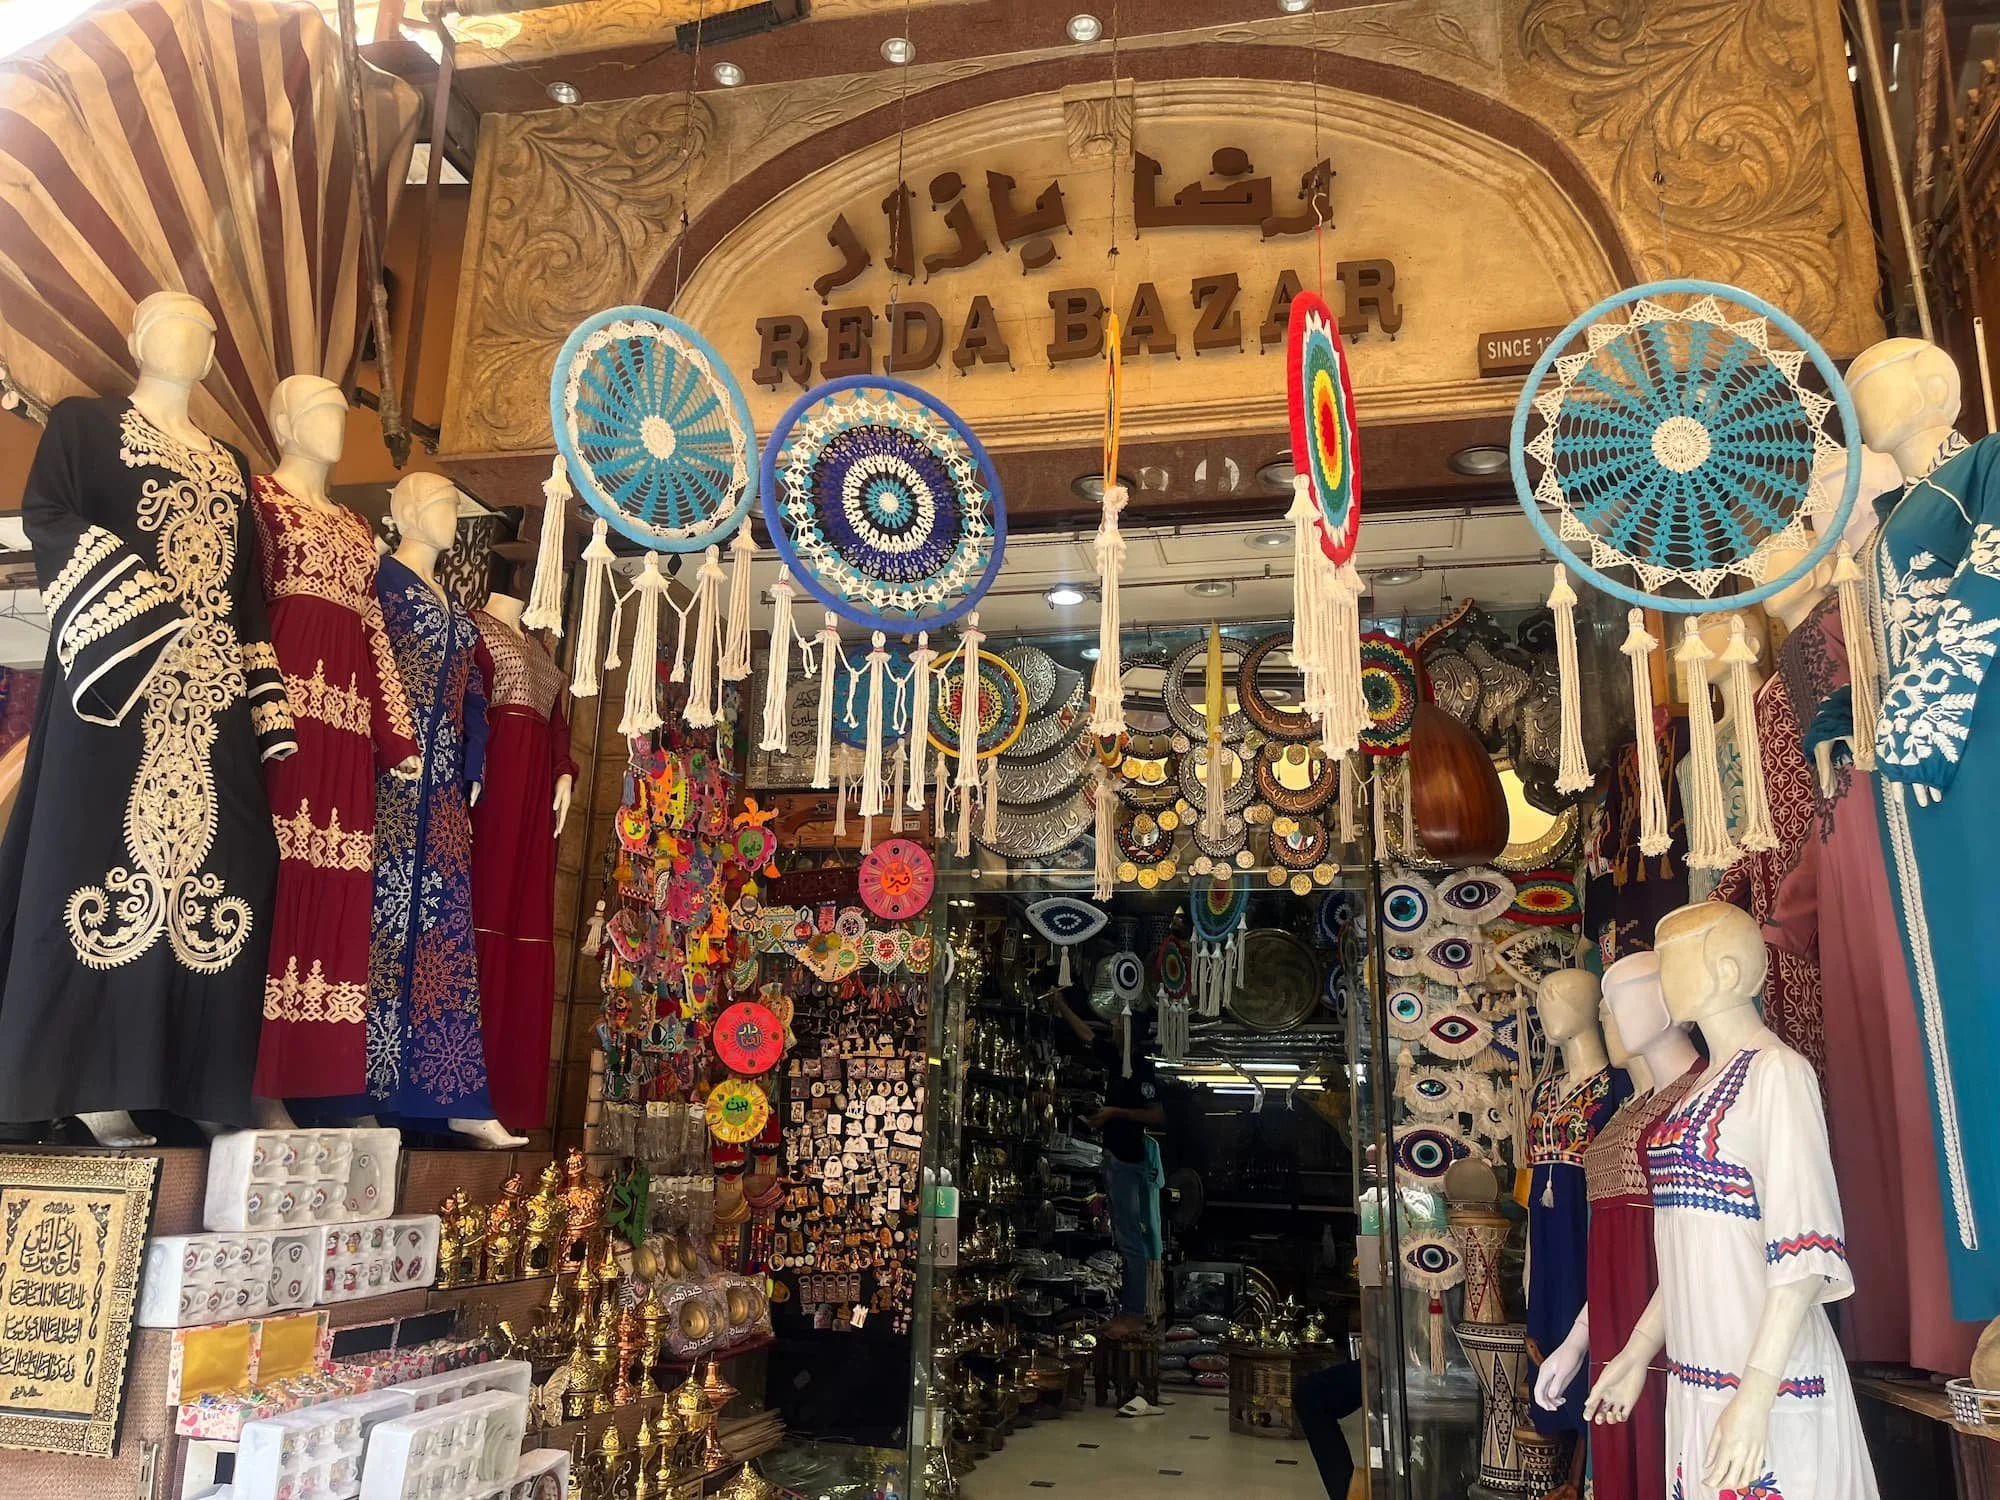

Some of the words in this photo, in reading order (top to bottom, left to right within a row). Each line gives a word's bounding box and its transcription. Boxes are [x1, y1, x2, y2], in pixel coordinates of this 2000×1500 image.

[813, 170, 1067, 297] بازار
[1134, 147, 1333, 239] رضا
[752, 295, 1010, 384] REDA
[1487, 338, 1532, 360] SINCE
